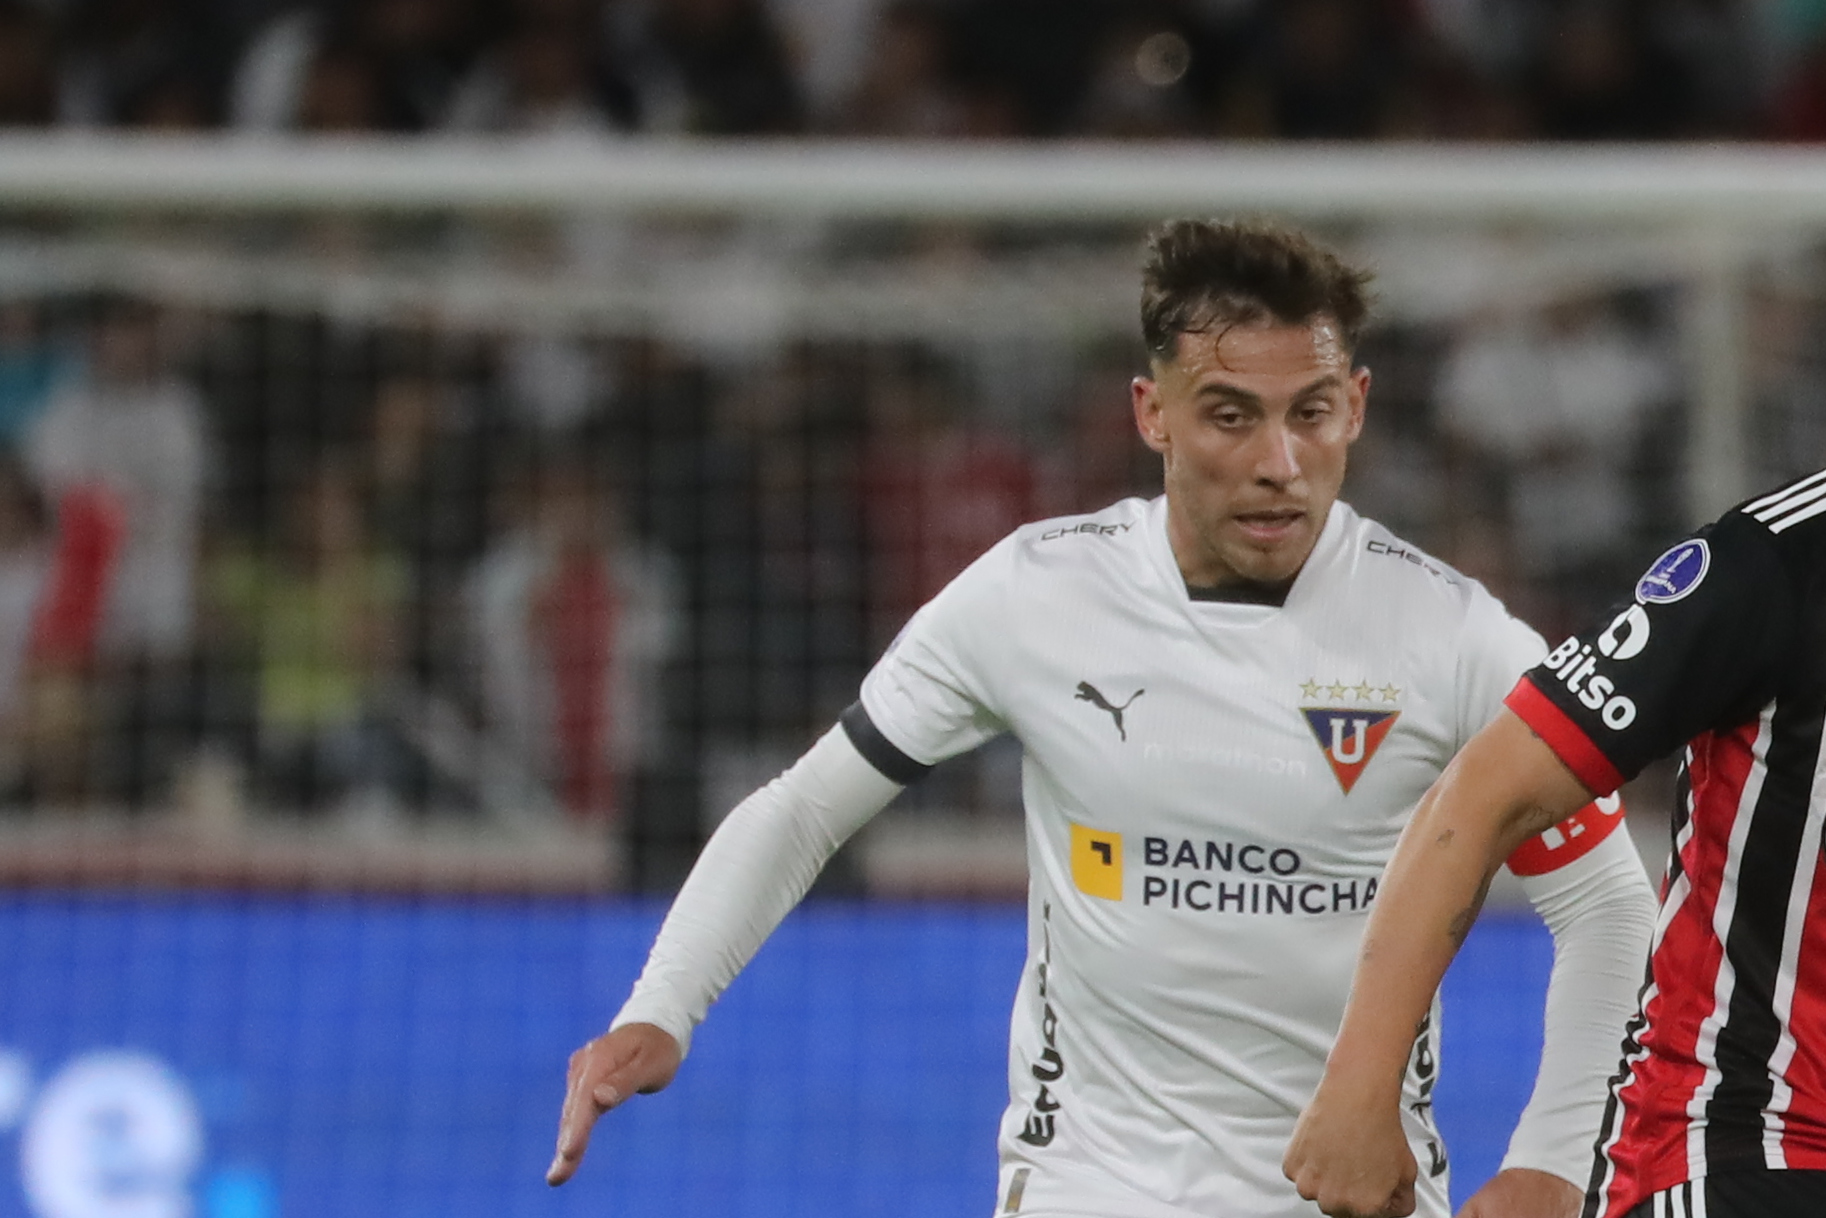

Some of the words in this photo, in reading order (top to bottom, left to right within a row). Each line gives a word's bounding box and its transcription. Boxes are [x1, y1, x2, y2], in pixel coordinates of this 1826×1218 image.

[1041, 521, 1136, 541] CHERY
[1543, 635, 1637, 730] Bitso
[1329, 718, 1369, 764] U
[1143, 836, 1301, 876] BANCO
